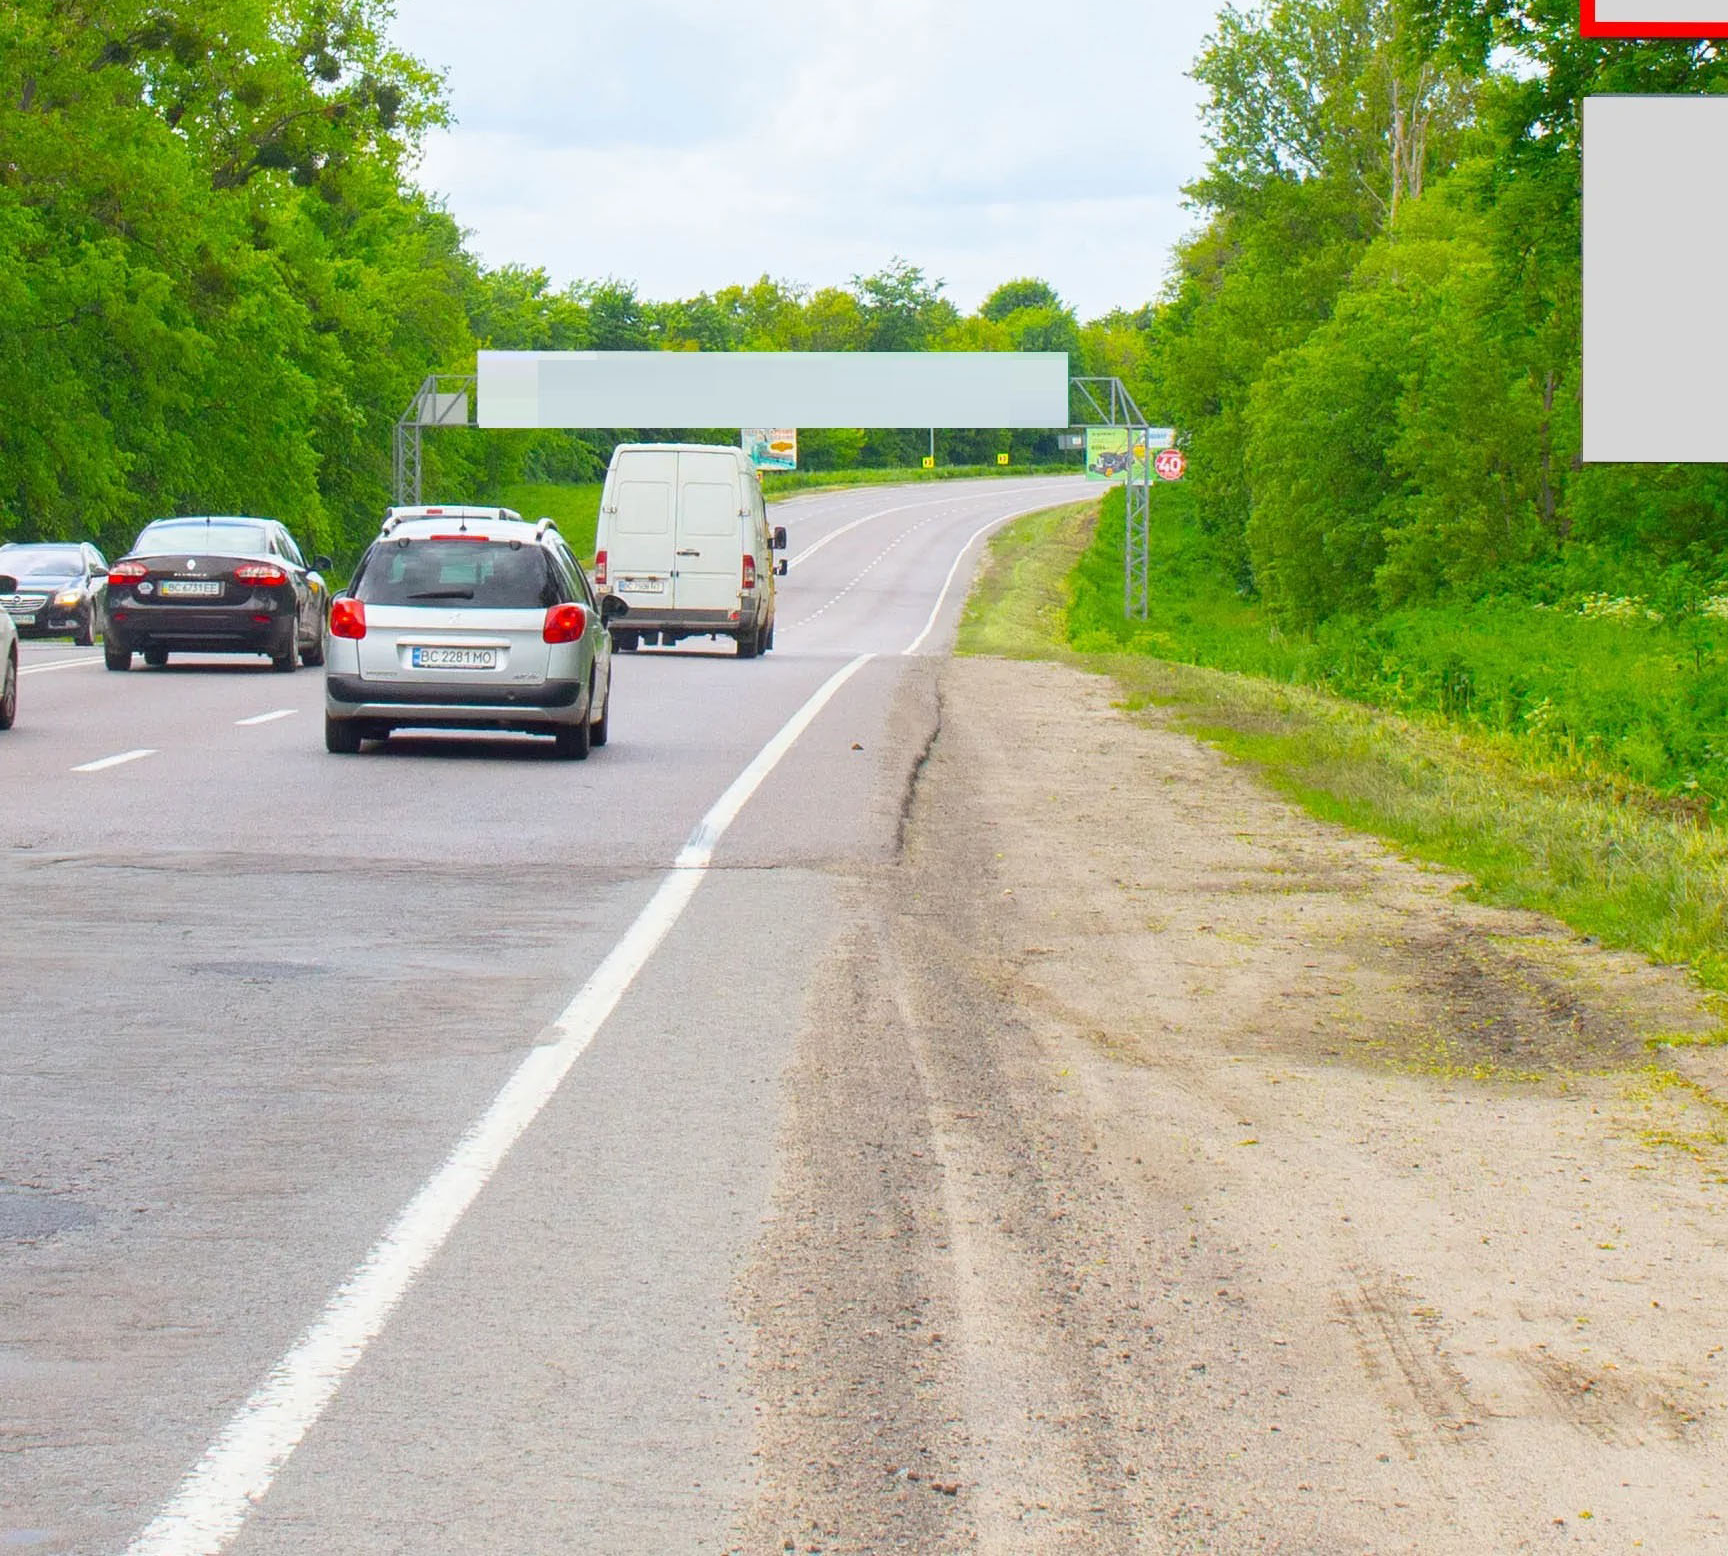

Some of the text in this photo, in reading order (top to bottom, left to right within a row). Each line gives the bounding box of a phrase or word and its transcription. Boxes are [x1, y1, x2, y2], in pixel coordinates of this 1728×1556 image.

[1158, 456, 1181, 472] 40
[421, 650, 491, 664] BC 2281 MO
